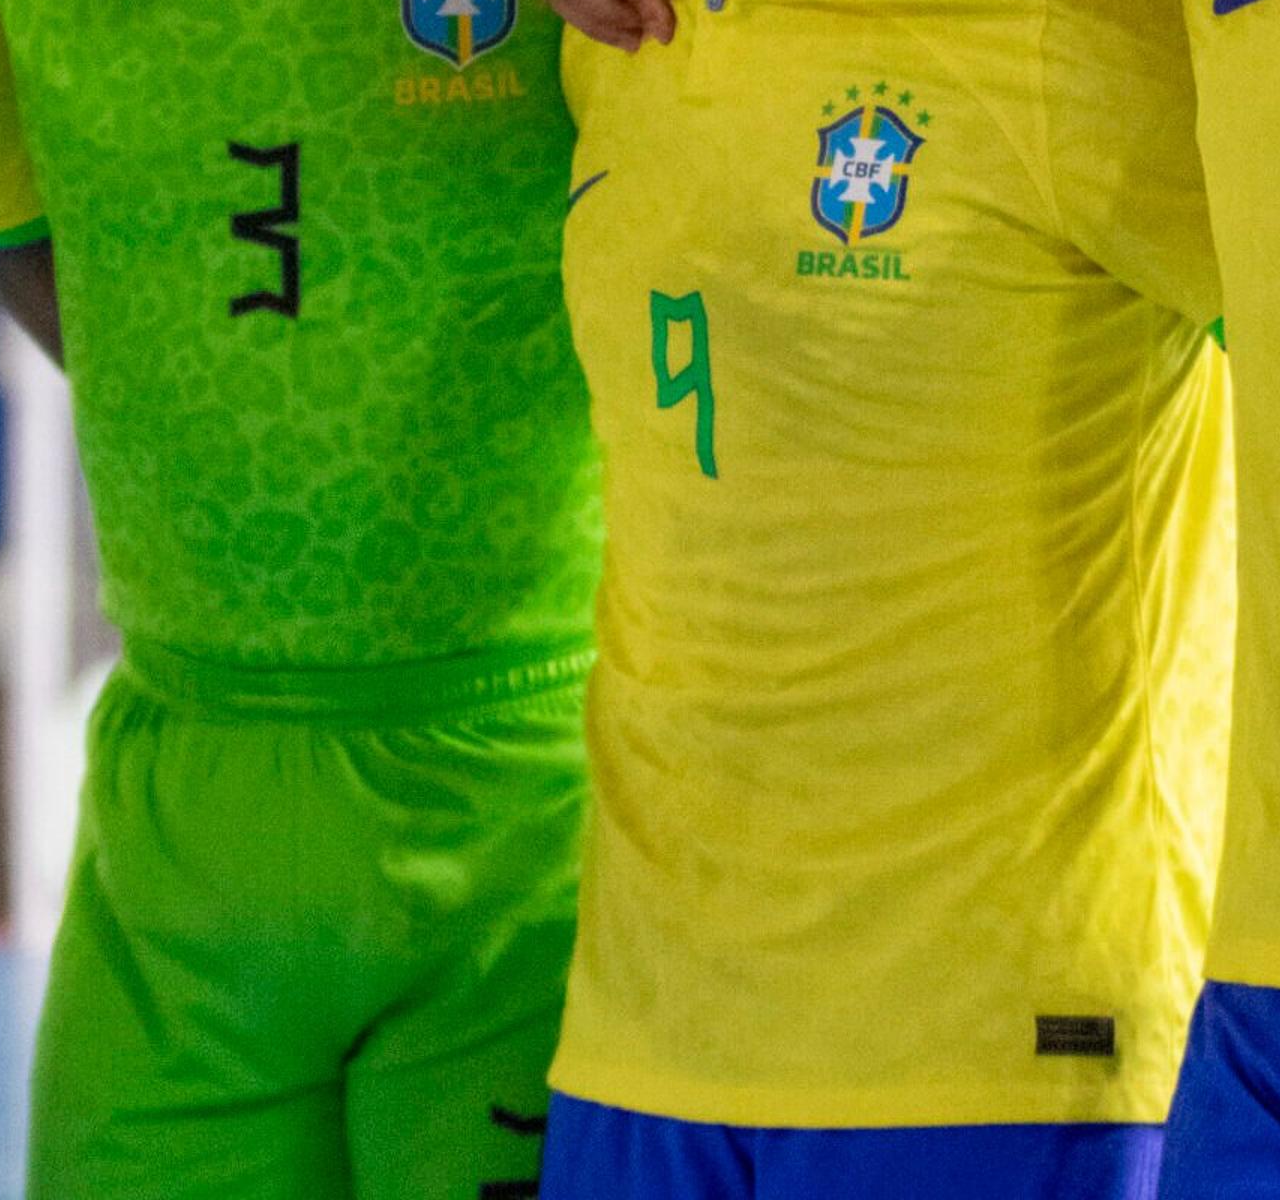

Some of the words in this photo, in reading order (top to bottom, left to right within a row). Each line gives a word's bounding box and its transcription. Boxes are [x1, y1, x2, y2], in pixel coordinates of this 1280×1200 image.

[394, 73, 527, 107] BRASIL
[842, 159, 882, 180] CBF
[227, 141, 302, 320] 3
[795, 250, 911, 282] BRASIL
[649, 289, 719, 480] 9
